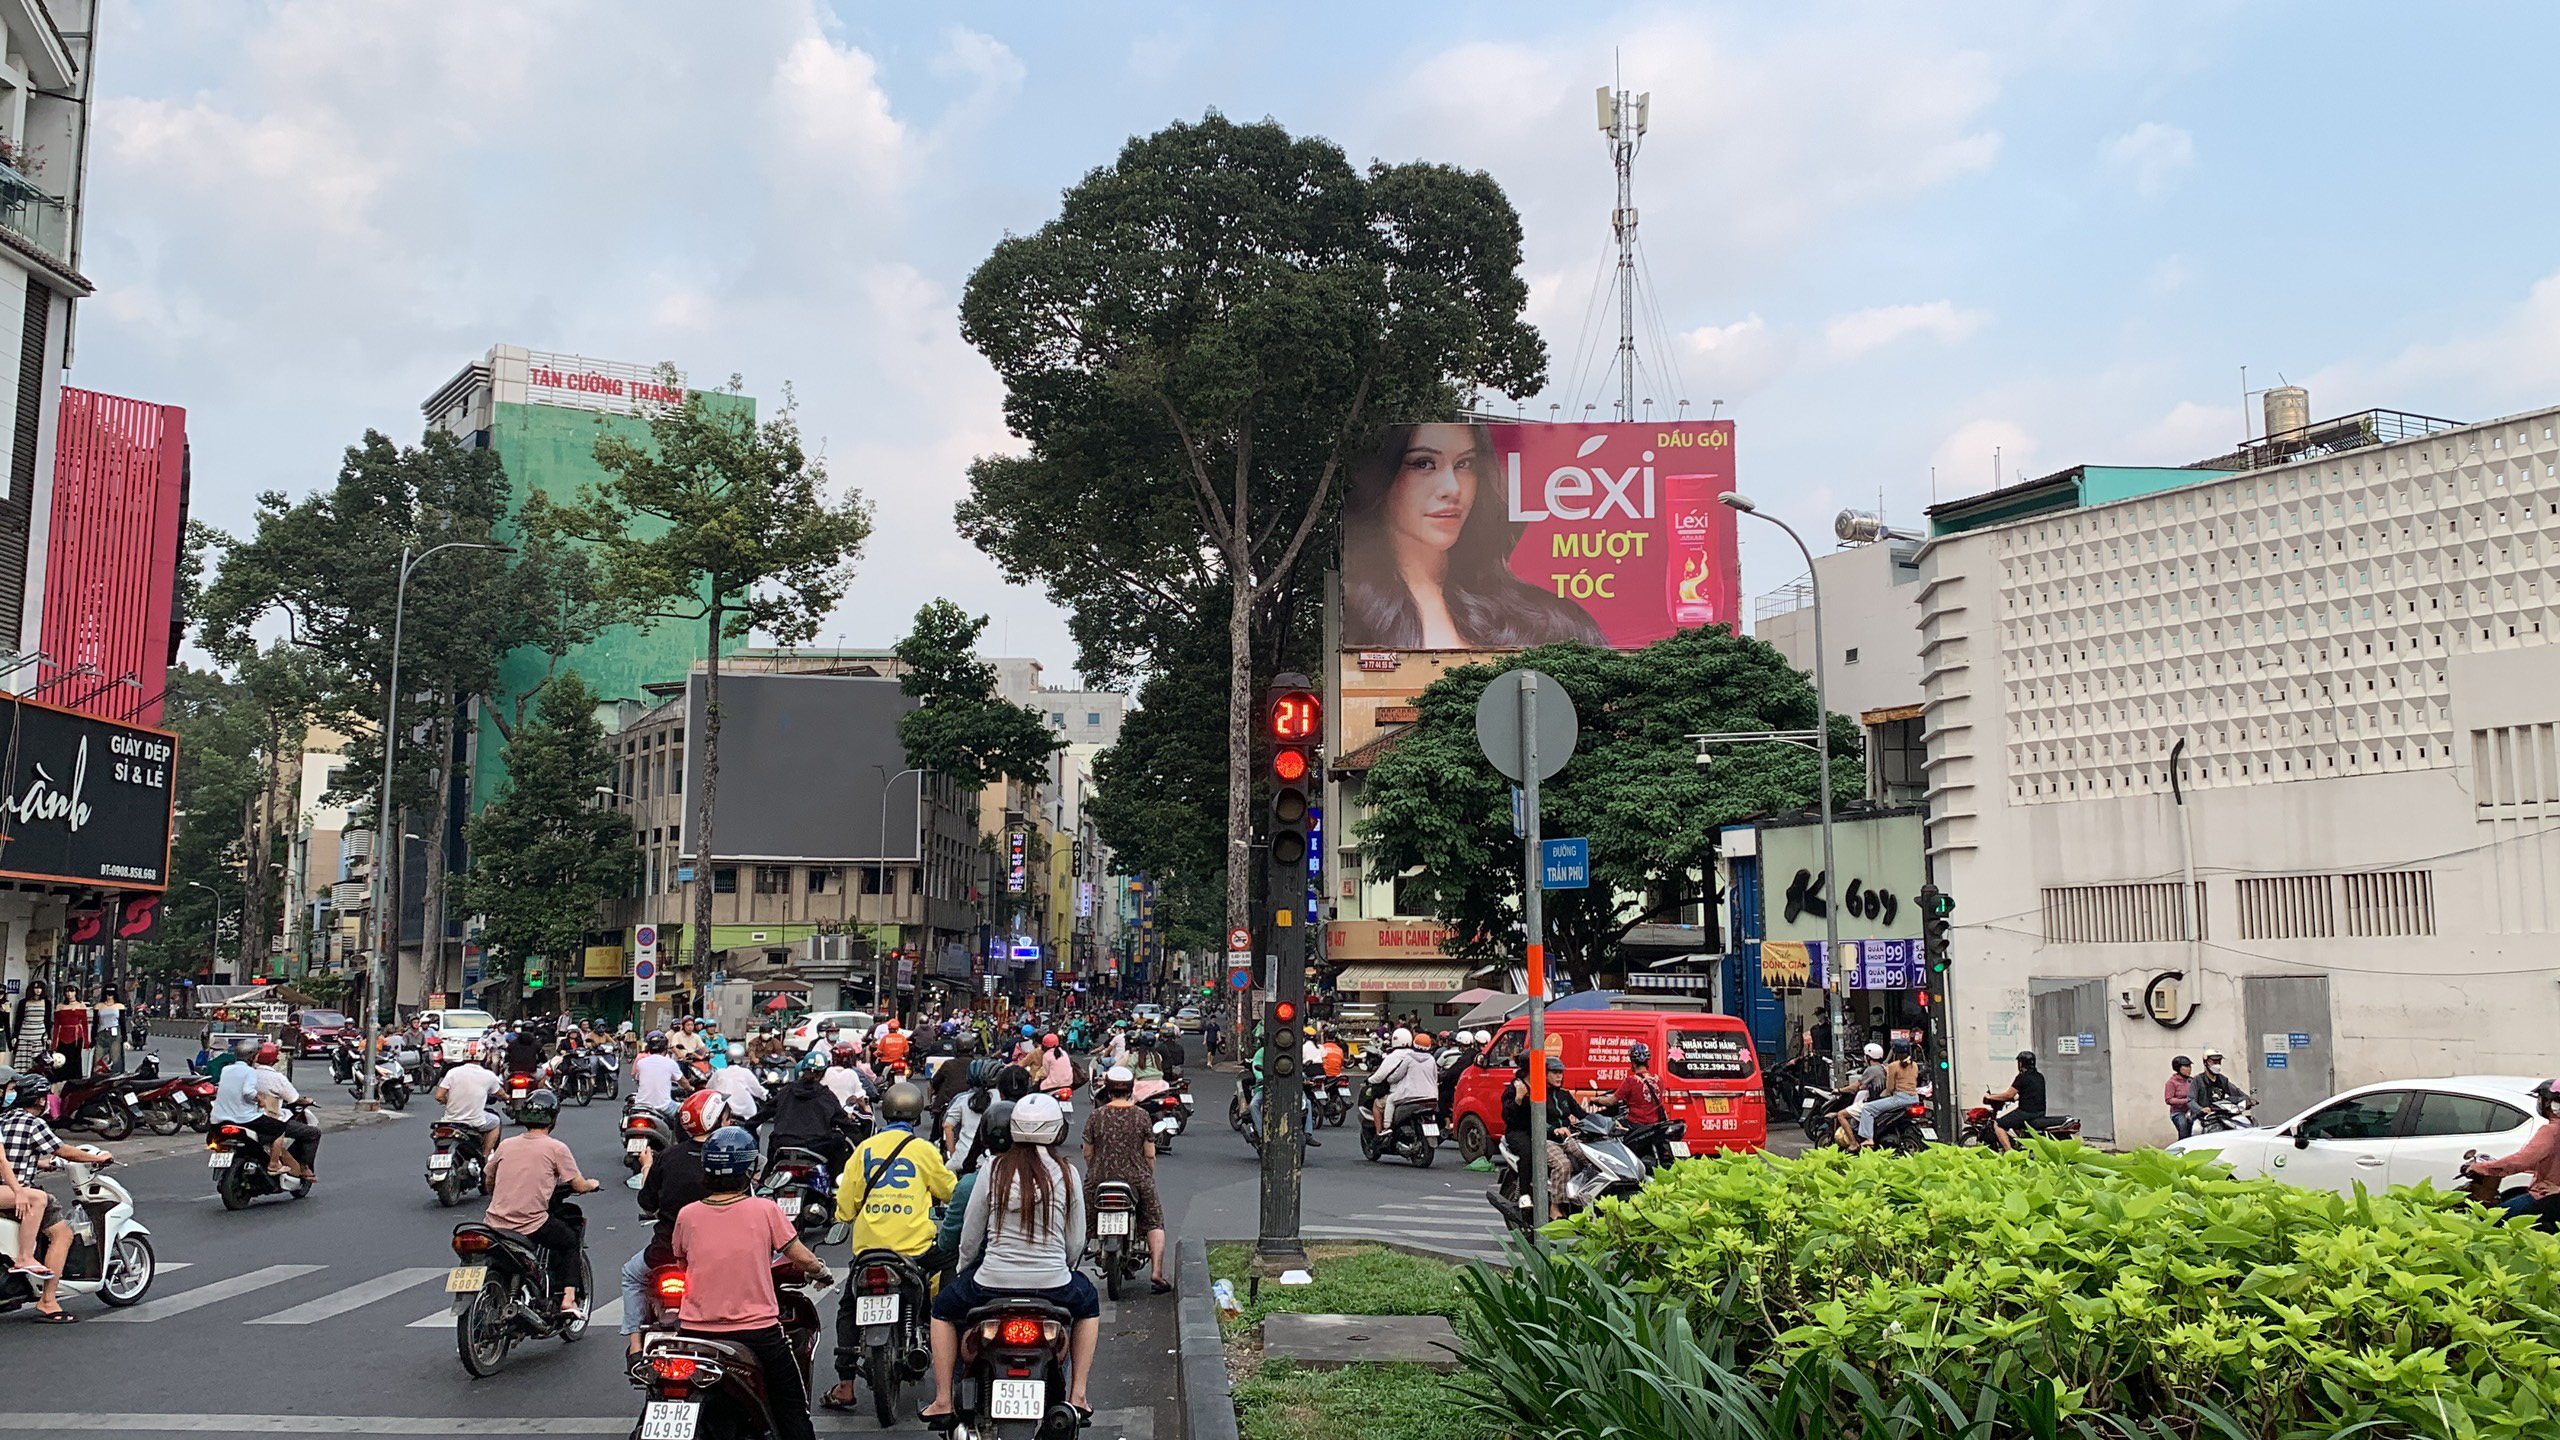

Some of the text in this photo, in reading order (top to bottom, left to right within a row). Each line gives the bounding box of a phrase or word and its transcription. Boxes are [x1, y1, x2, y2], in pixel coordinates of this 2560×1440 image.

[530, 364, 563, 388] TÂN
[567, 371, 623, 396] CƯỜNG
[1697, 429, 1728, 451] GỘI
[1552, 529, 1649, 564] MƯỢT
[1551, 568, 1615, 599] TÓC
[1277, 702, 1309, 734] 21
[110, 732, 171, 762] GIÀY DÉP
[114, 758, 164, 788] SỈ & LẺ
[1552, 843, 1577, 857] ĐƯỜNG
[1568, 862, 1584, 881] PHÚ
[1378, 926, 1403, 947] BÁNH
[1405, 930, 1430, 947] CANH
[1682, 1039, 1703, 1049] NHẬN
[864, 1147, 916, 1189] be
[451, 1279, 478, 1290] 6002
[863, 1297, 892, 1310] 51-L7
[863, 1309, 892, 1322] 0578
[1000, 1383, 1035, 1400] 59-L1
[652, 1404, 691, 1421] 59-H2
[995, 1399, 1040, 1416] 063.19
[644, 1421, 693, 1439] 049.95
